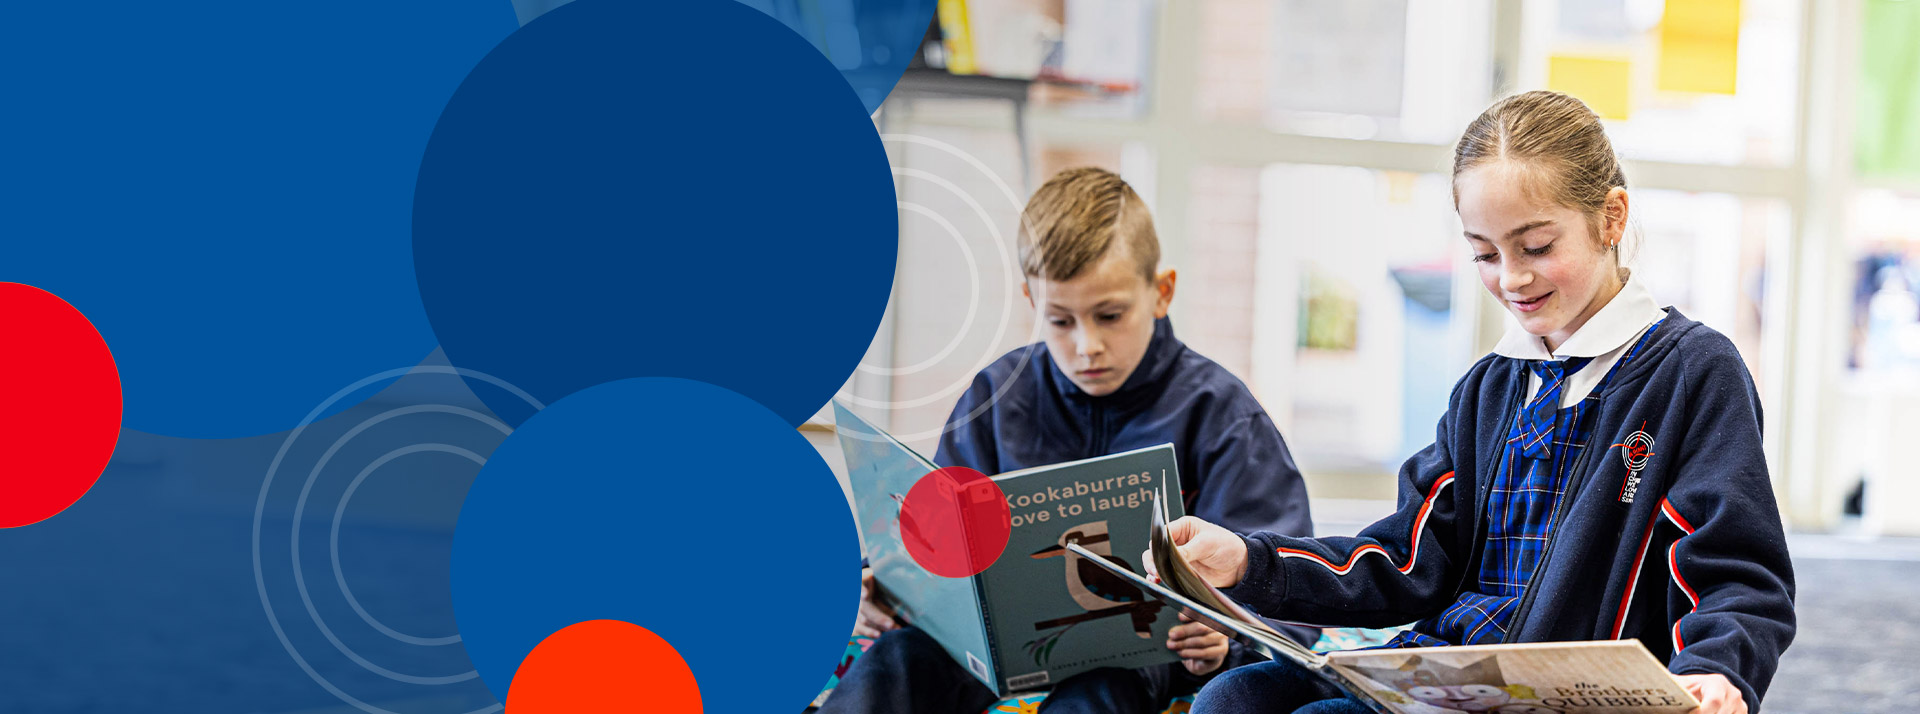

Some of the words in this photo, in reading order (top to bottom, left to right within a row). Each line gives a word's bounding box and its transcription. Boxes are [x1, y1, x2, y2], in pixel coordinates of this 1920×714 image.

[1000, 471, 1152, 510] Kookaburras
[1057, 503, 1083, 518] to
[1554, 685, 1667, 697] Brothers
[1542, 696, 1682, 709] QUIBBLE
